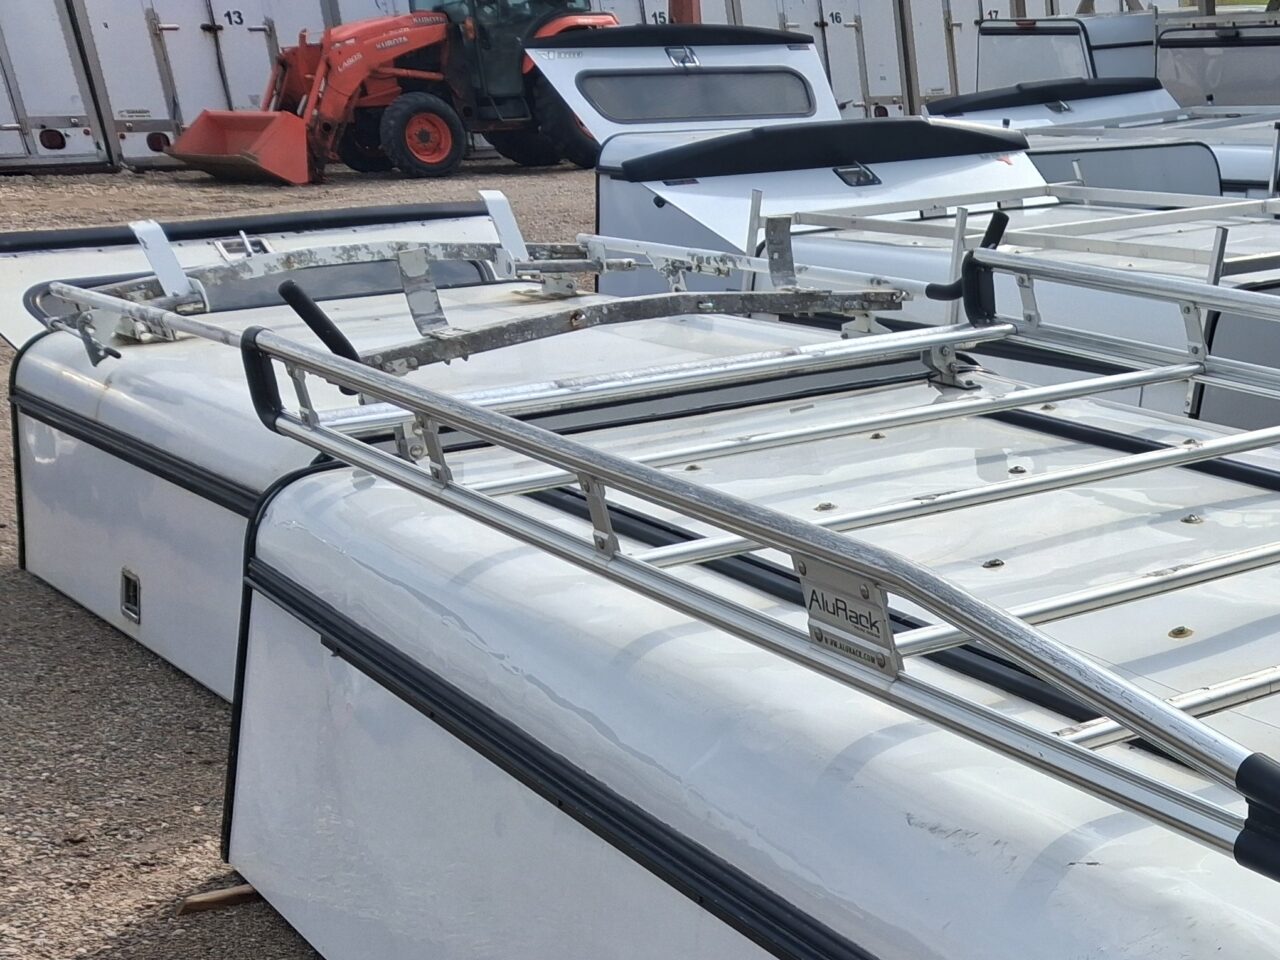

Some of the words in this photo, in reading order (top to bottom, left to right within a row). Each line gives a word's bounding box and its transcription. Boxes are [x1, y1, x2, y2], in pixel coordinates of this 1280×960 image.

[224, 10, 244, 25] 13
[651, 11, 667, 24] 15
[829, 12, 842, 24] 16
[987, 10, 999, 19] 17
[375, 35, 409, 49] KUBOTA
[808, 589, 881, 634] AluRack
